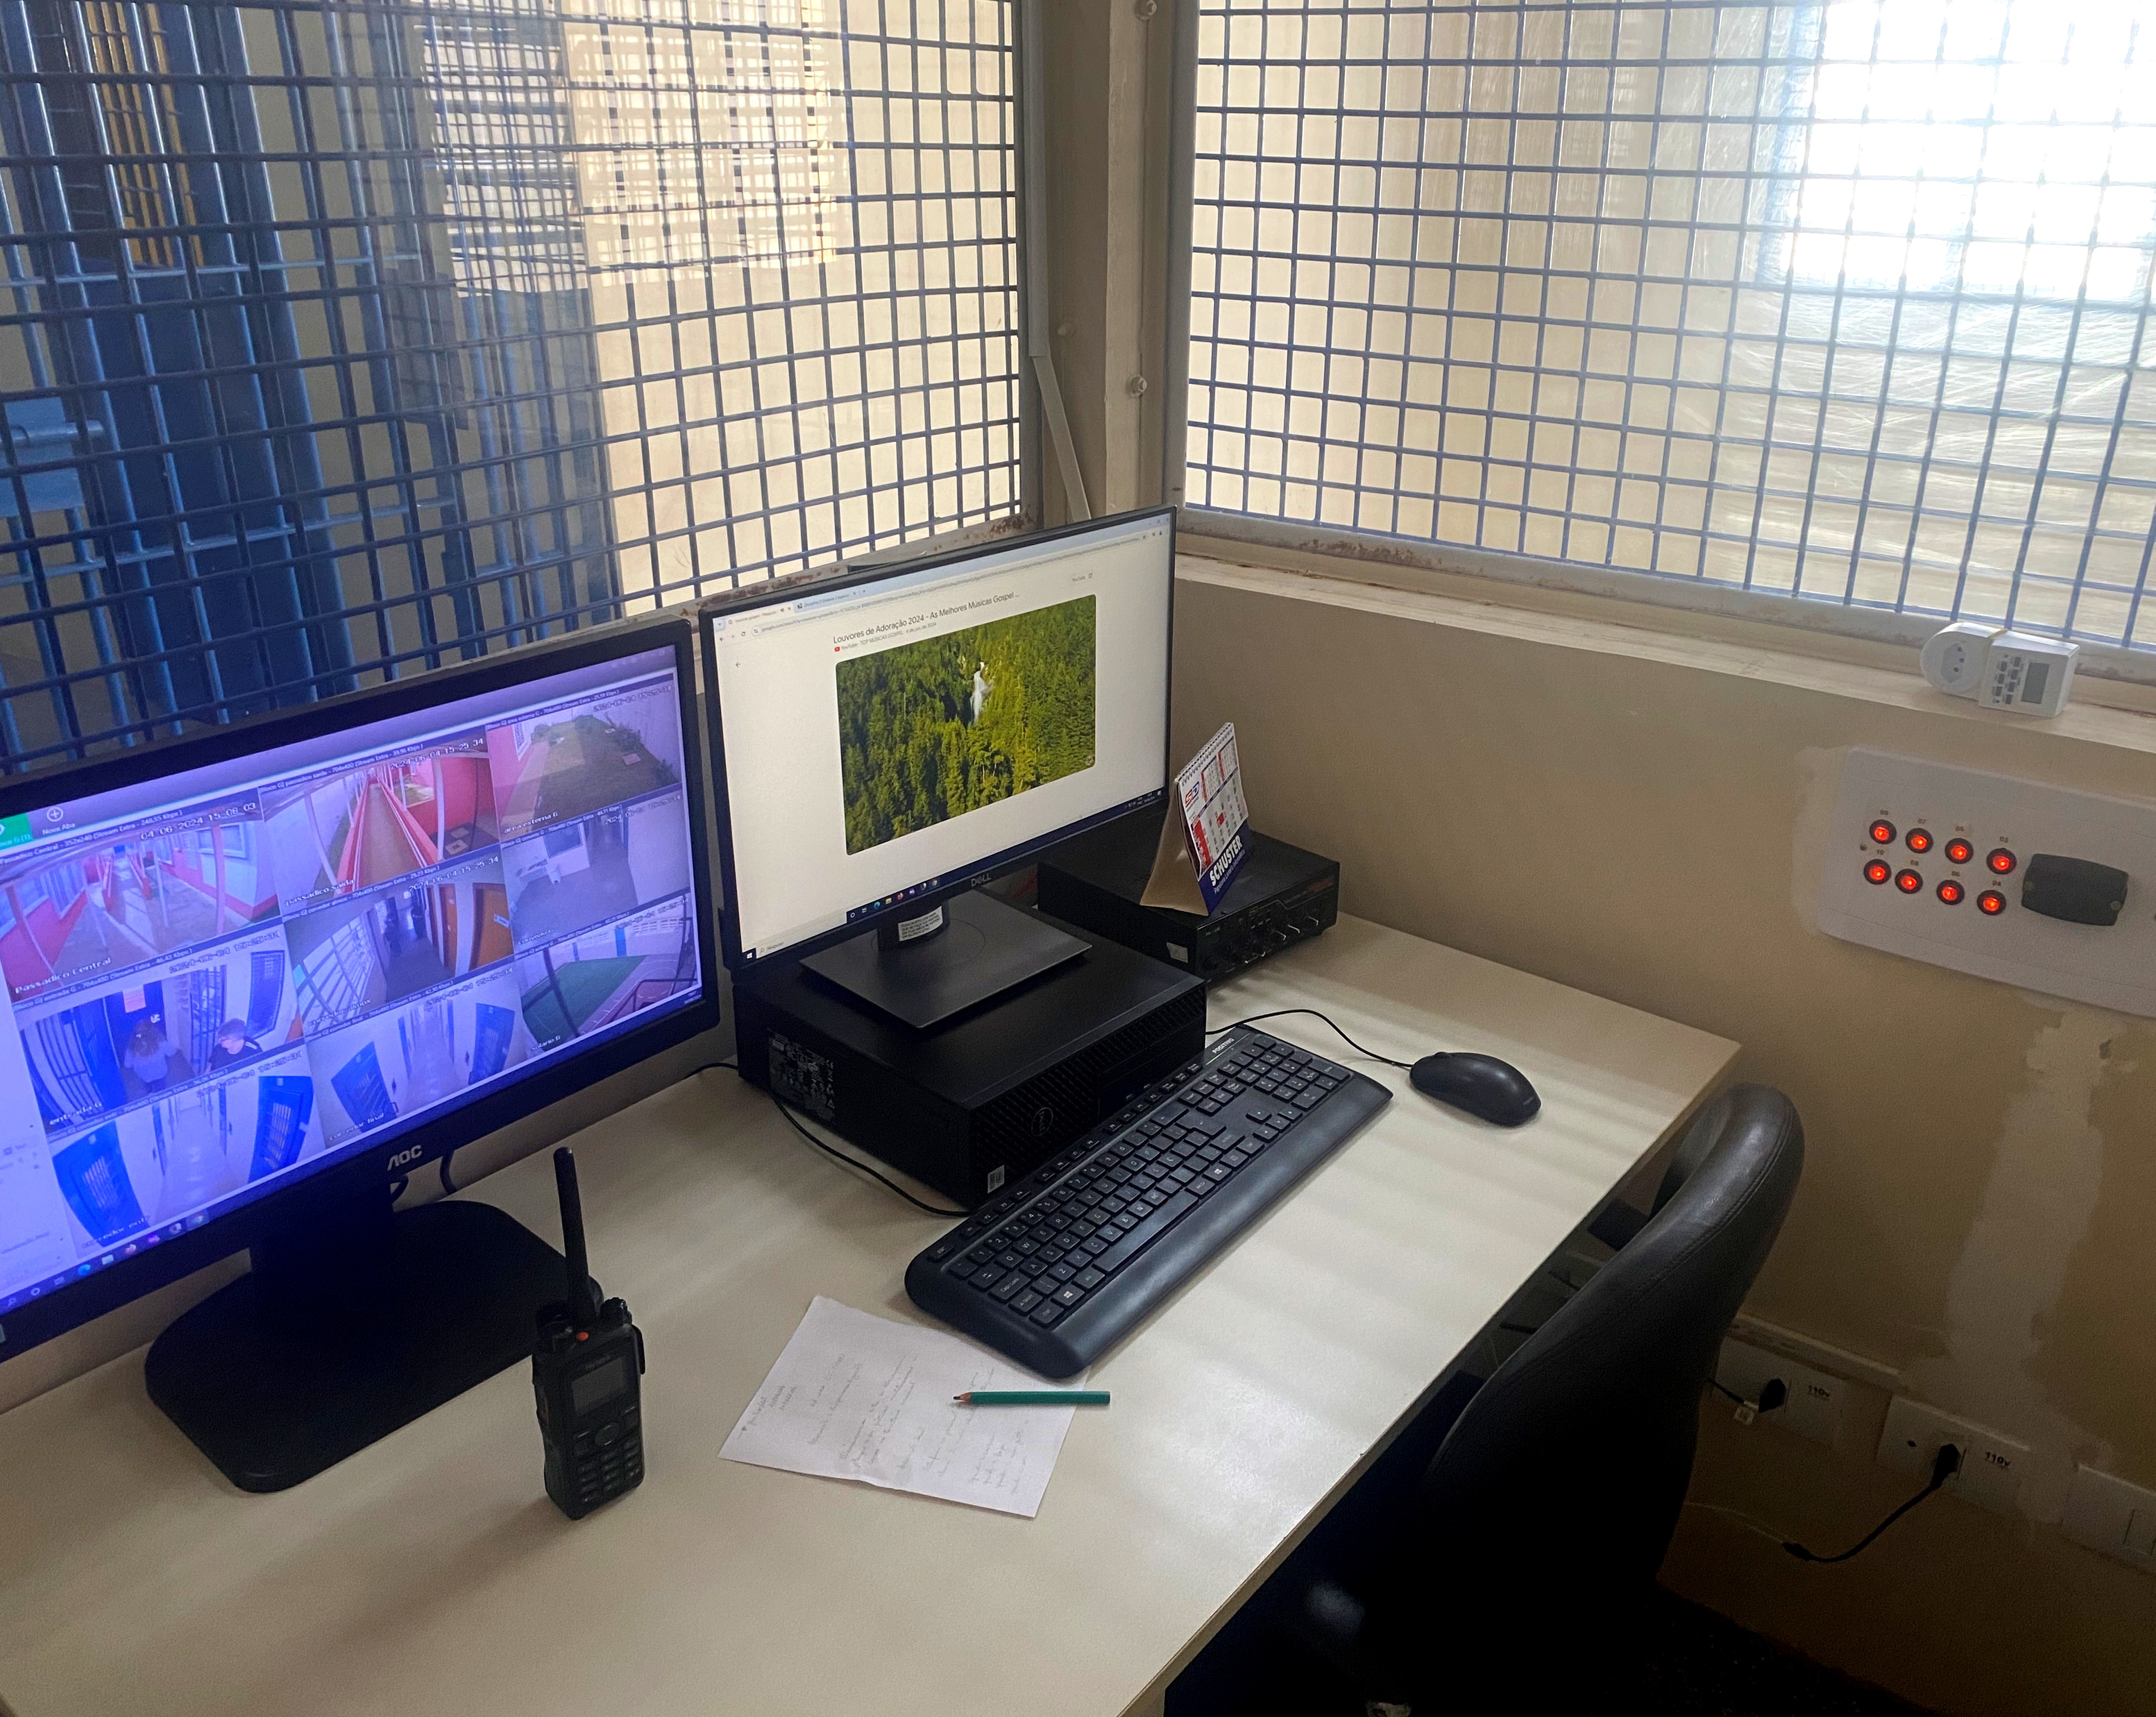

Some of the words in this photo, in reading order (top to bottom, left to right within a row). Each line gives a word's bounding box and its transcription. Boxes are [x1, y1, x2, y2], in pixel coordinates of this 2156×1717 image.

[833, 631, 864, 644] Louvores
[876, 619, 907, 634] Adoração
[908, 614, 924, 625] 2024
[939, 604, 967, 617] Melhores
[968, 598, 992, 609] Músicas
[993, 592, 1014, 603] Gospel
[43, 826, 60, 835] Nova
[1209, 835, 1243, 886] SCHUSTER
[971, 873, 992, 887] DELL
[1212, 1038, 1235, 1053] POSITIVO
[387, 1145, 422, 1171] AOC
